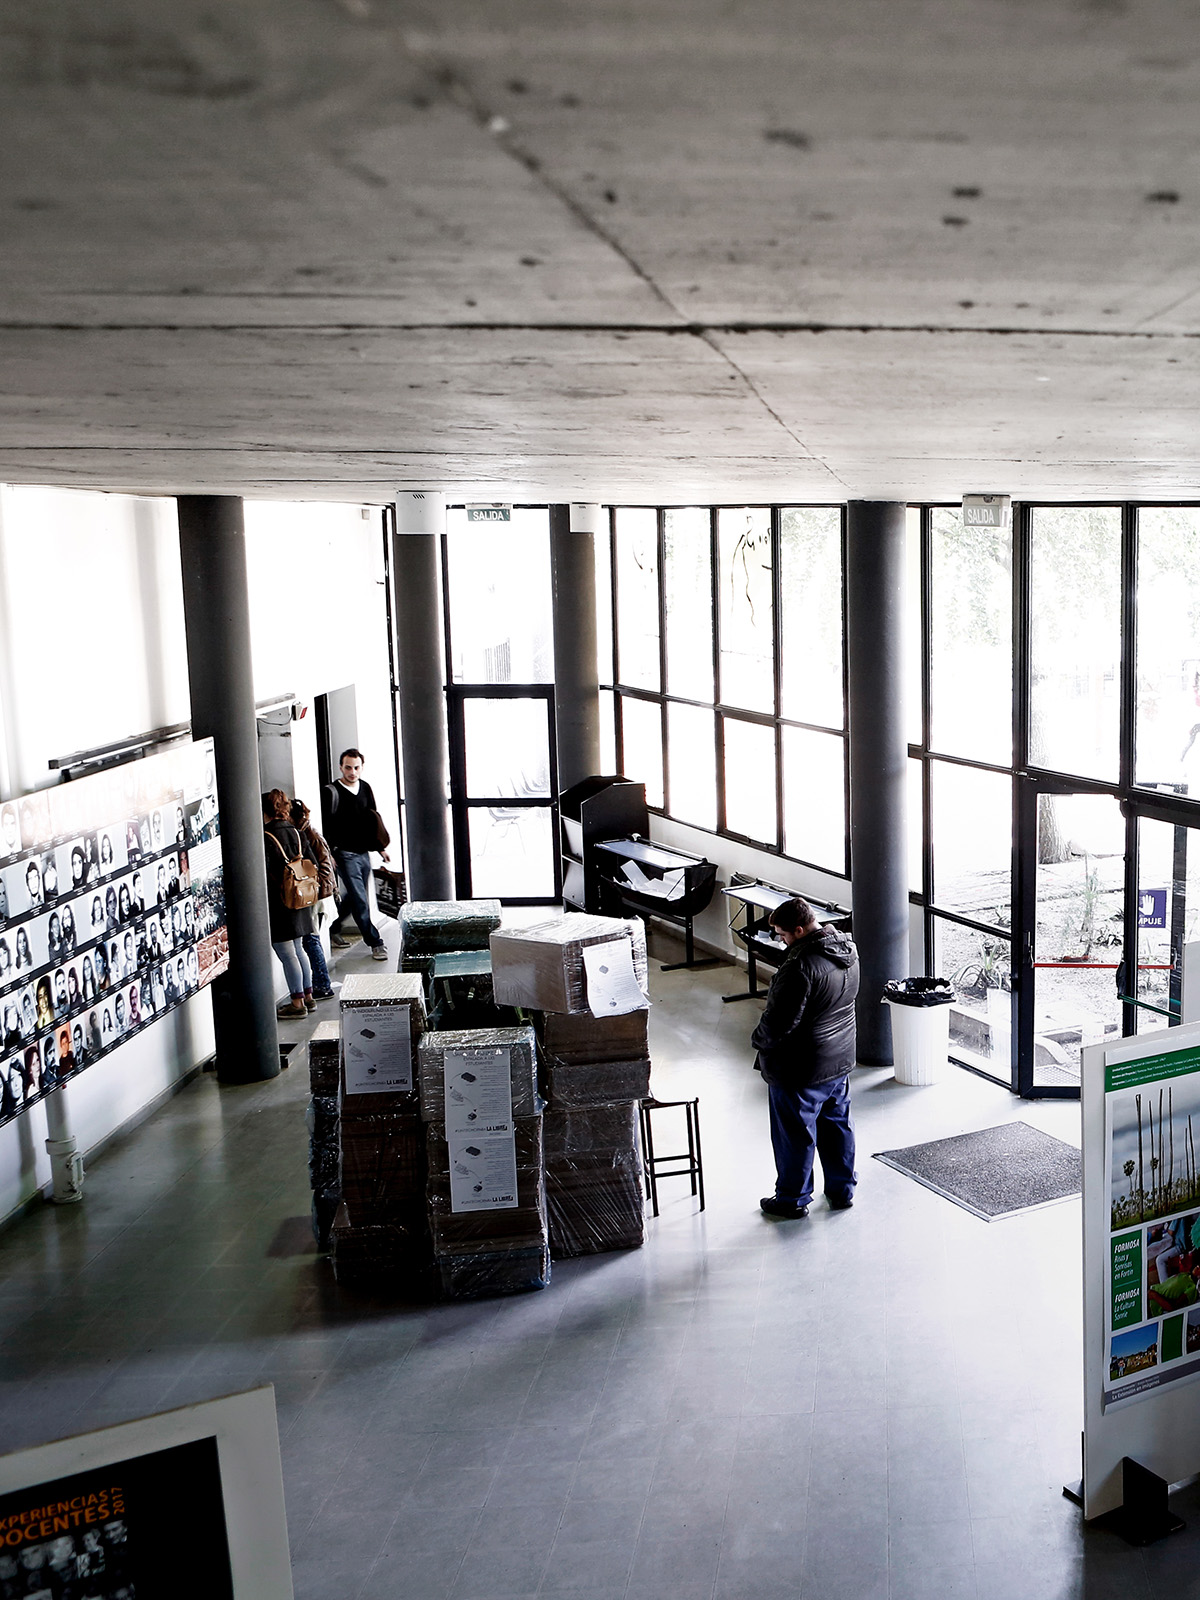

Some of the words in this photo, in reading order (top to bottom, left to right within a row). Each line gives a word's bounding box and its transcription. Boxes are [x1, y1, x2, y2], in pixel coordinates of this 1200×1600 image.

[473, 511, 504, 521] SALIDA
[968, 508, 994, 524] SALIDA
[1138, 917, 1162, 925] MPUJE
[1114, 1238, 1140, 1254] FORMOSA
[1114, 1287, 1140, 1303] FORMOSA
[111, 1487, 125, 1515] 2017
[0, 1489, 108, 1530] XPERIENCIAS
